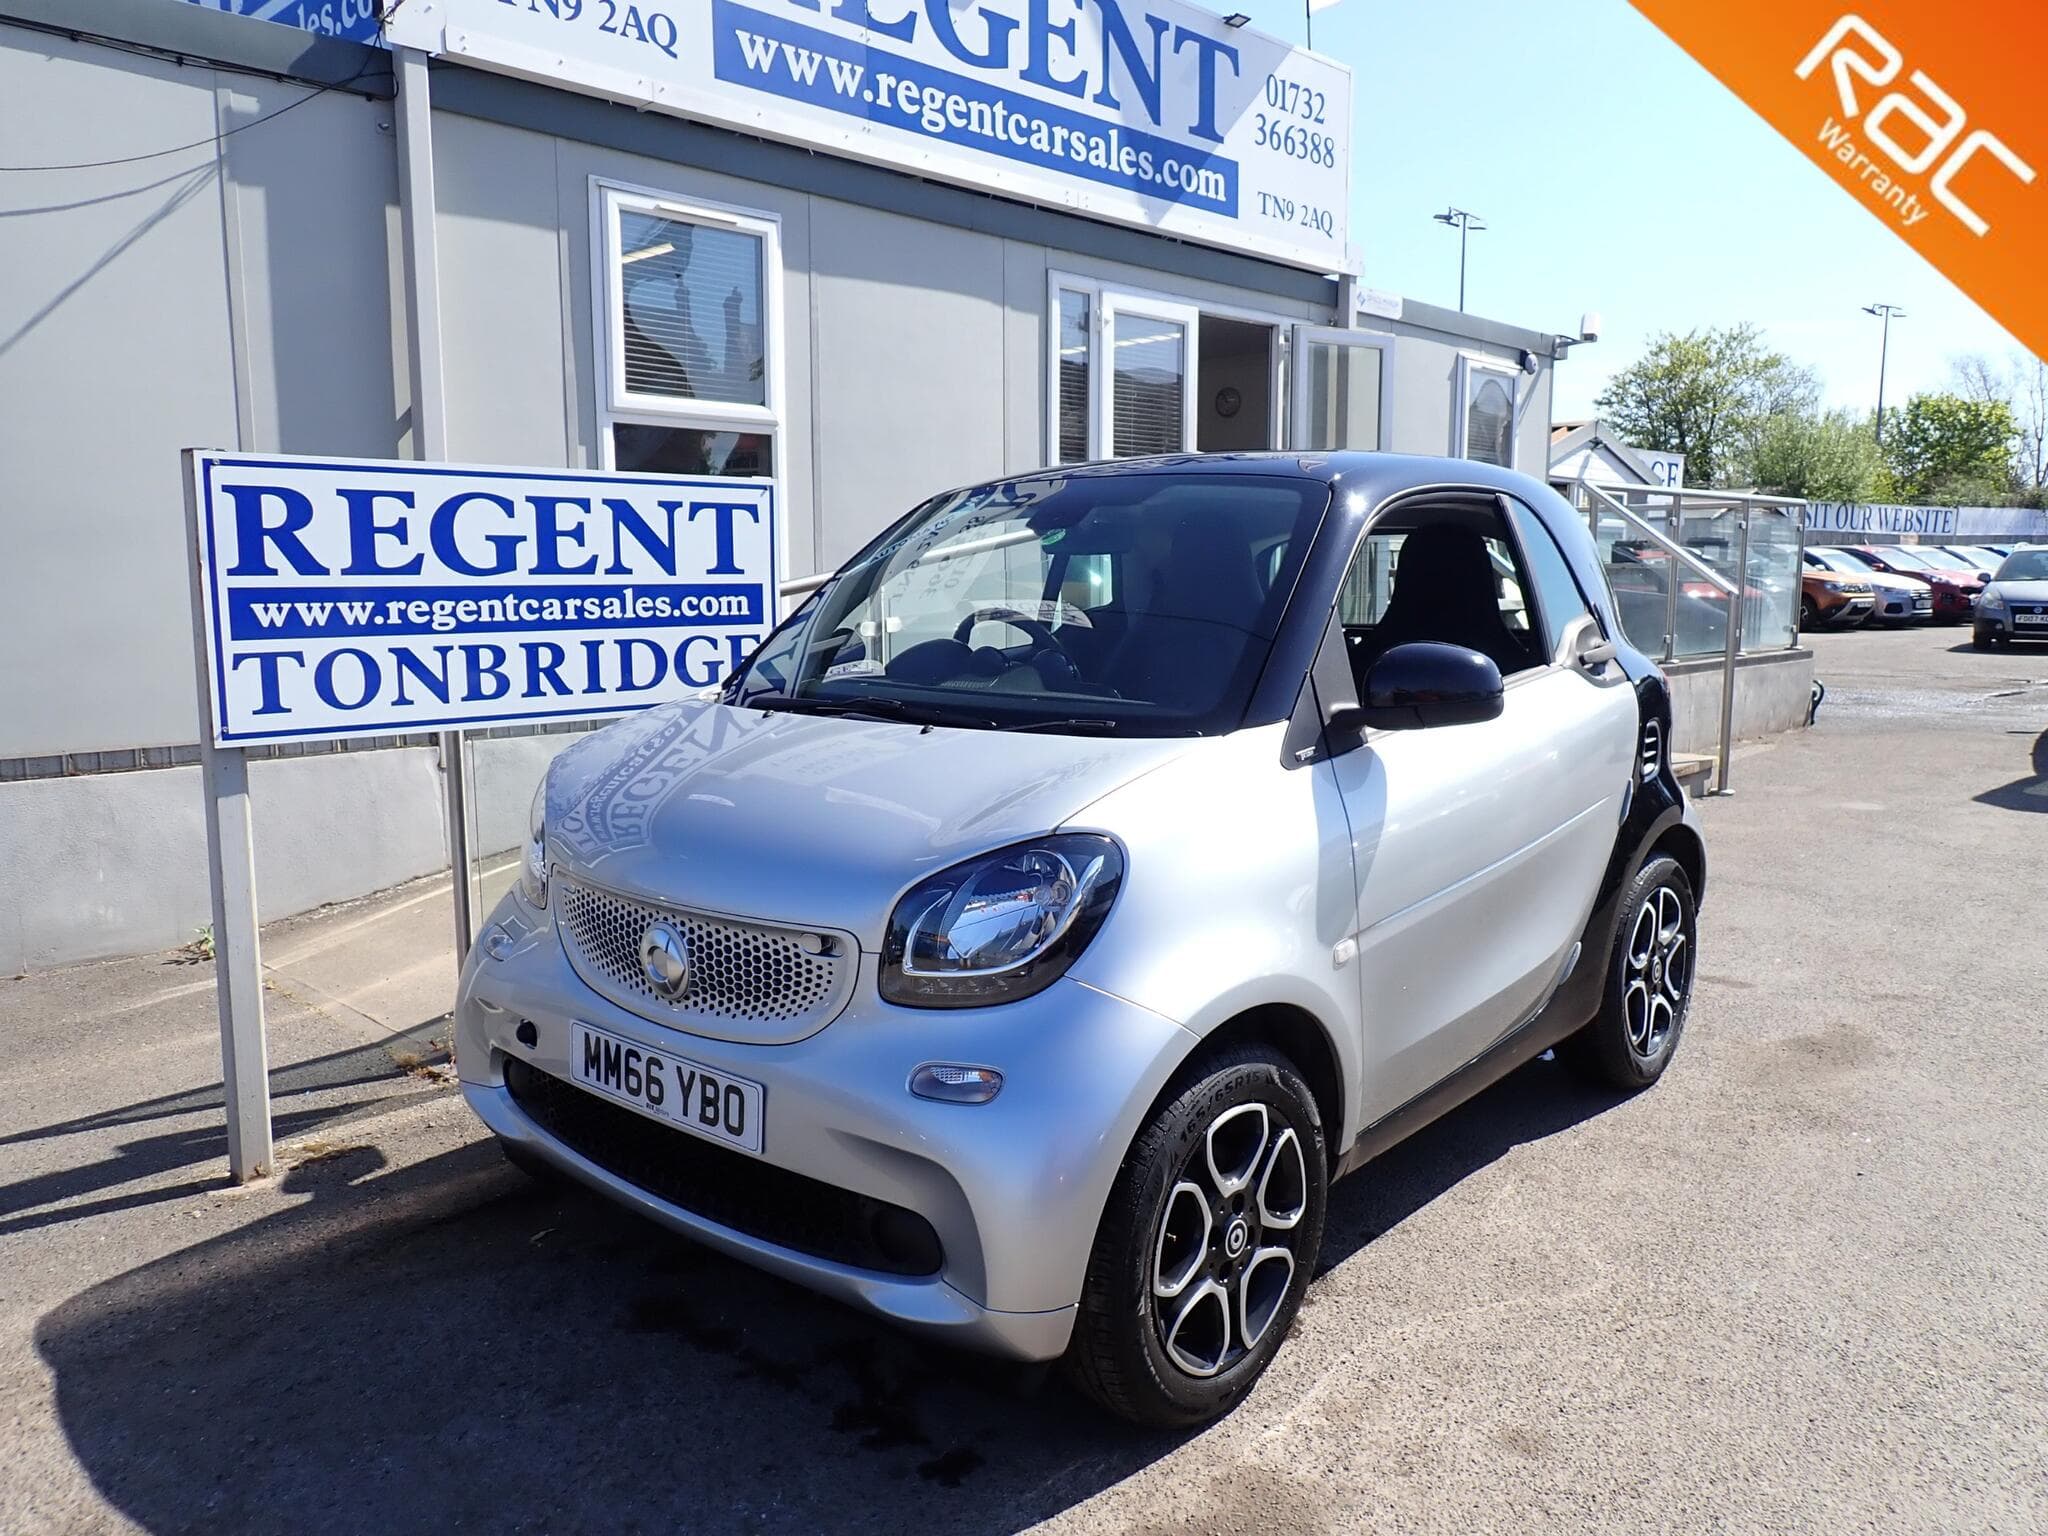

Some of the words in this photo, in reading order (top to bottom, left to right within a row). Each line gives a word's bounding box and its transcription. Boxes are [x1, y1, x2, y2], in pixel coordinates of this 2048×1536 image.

[599, 0, 678, 59] 2AQ
[788, 0, 1240, 143] GENT
[1266, 74, 1325, 124] 01732
[735, 29, 1227, 203] www.regentcarsales.com
[1255, 113, 1334, 168] 366388
[1257, 191, 1295, 221] TN9
[1300, 205, 1333, 239] 2AQ
[221, 485, 760, 577] REGENT
[1836, 504, 1873, 531] OUR
[1879, 507, 1953, 533] WEBSITE
[250, 588, 750, 631] www.regentcarsales.com
[583, 1031, 665, 1106] MM66
